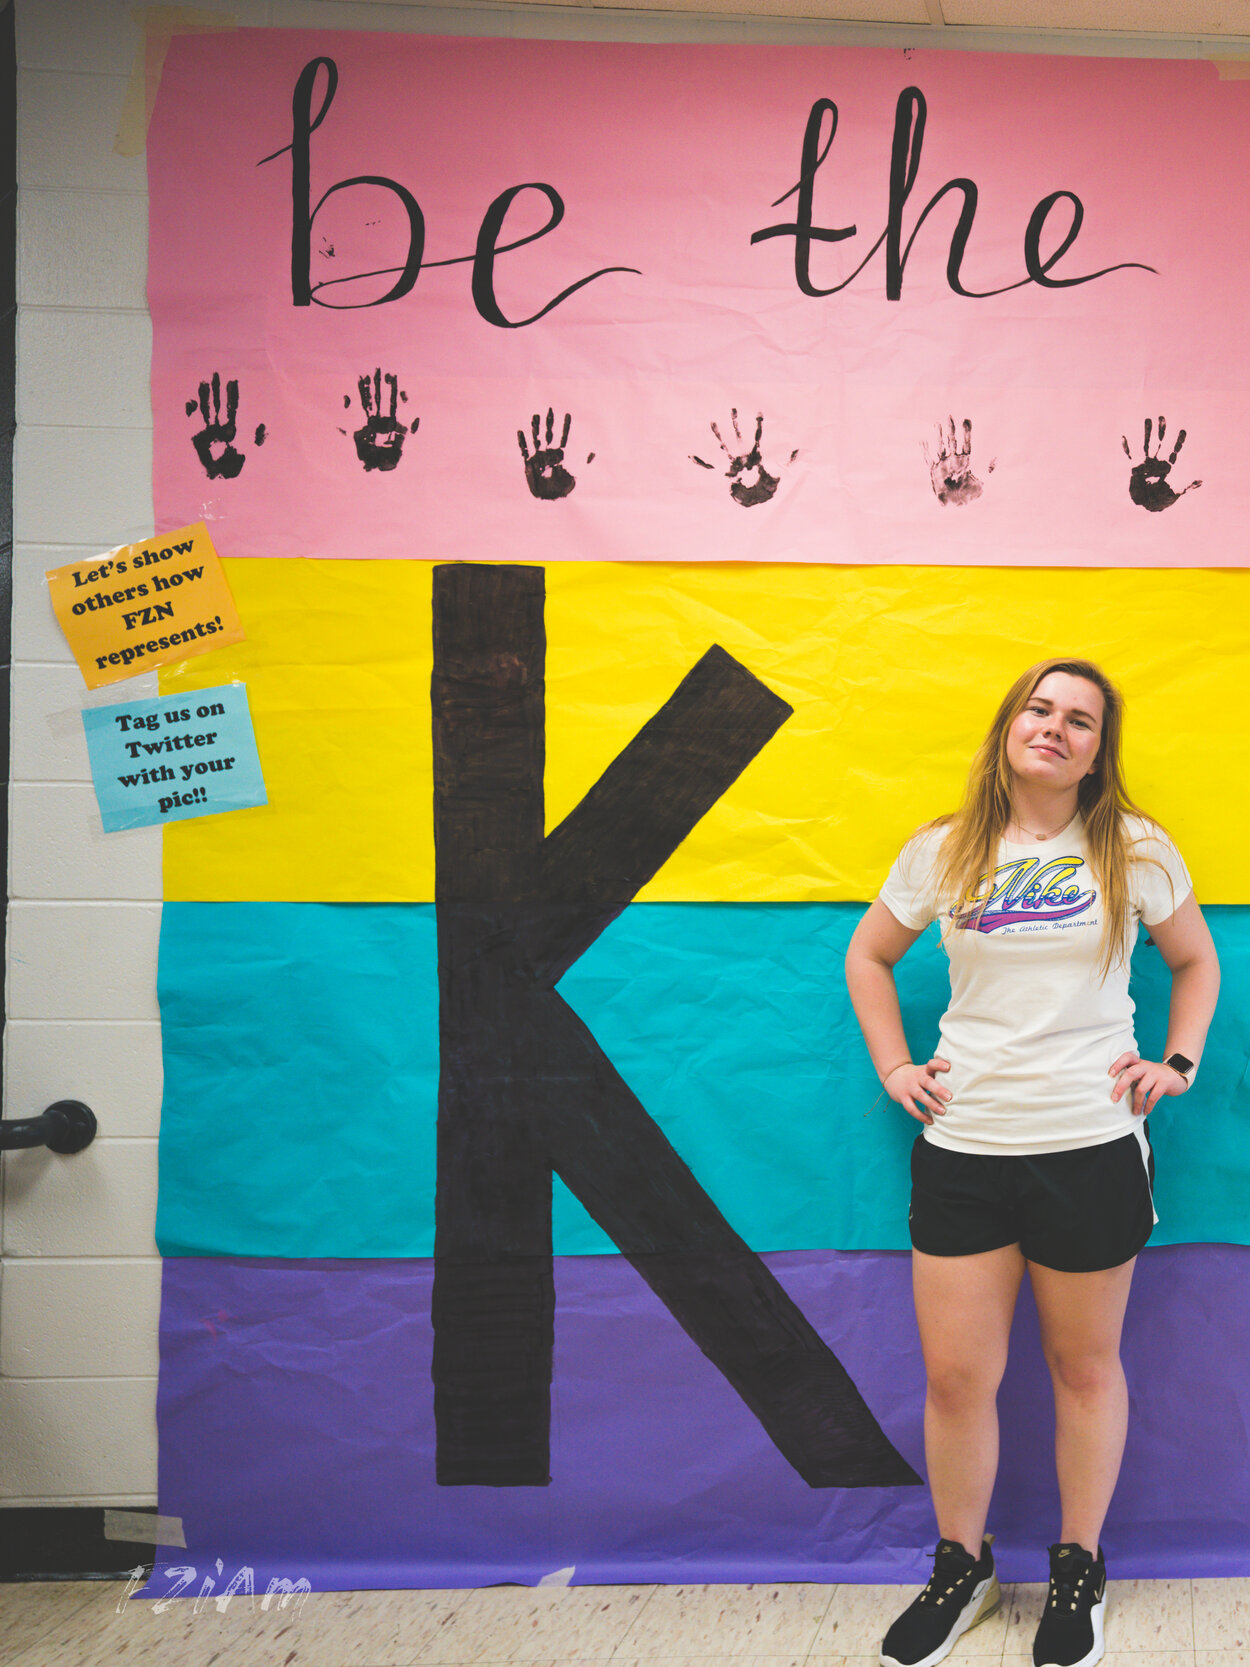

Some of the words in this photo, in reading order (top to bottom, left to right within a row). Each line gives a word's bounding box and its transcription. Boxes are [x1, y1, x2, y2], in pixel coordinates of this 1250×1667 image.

[257, 56, 643, 328] be
[751, 86, 1160, 300] the
[72, 561, 127, 587] Let's
[133, 541, 193, 568] show
[72, 584, 148, 615] others
[152, 567, 203, 591] how
[122, 602, 173, 630] FZN
[96, 616, 223, 669] represents!
[116, 714, 159, 731] Tag
[164, 709, 190, 723] us
[197, 704, 225, 717] on
[125, 733, 217, 758] Twitter
[118, 766, 175, 787] with
[180, 758, 235, 780] your
[158, 786, 208, 813] pic!!
[963, 856, 1090, 912] Nike
[1001, 927, 1015, 935] The
